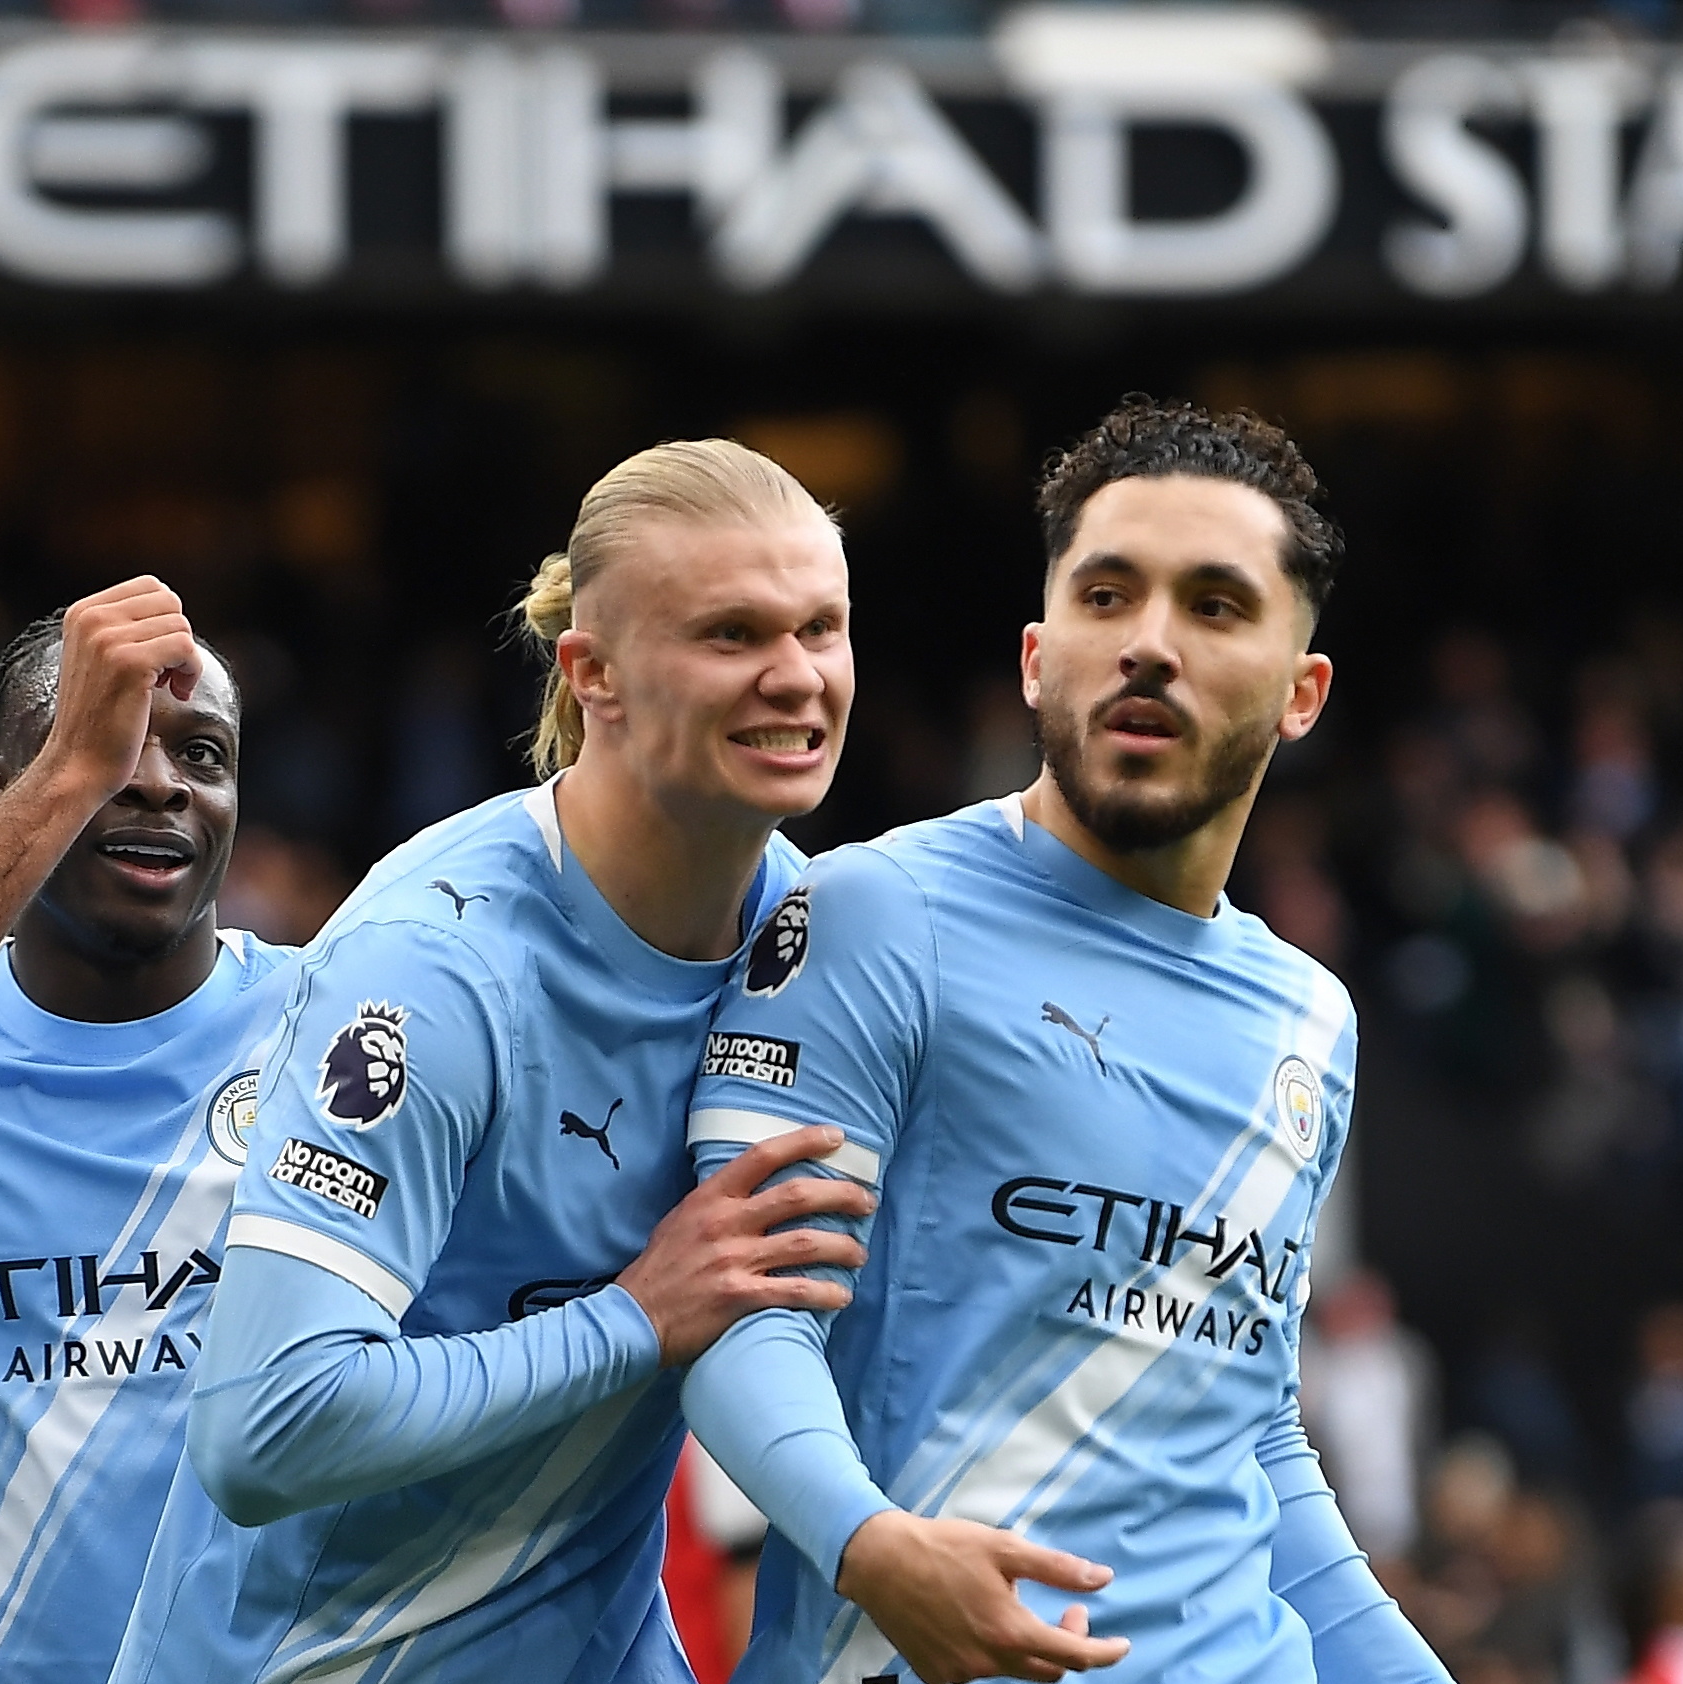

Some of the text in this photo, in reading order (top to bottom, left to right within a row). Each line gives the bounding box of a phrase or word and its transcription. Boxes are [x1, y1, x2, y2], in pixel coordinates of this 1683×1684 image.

[706, 1033, 787, 1065] No room
[721, 1058, 794, 1086] racism
[268, 1157, 377, 1219] for racism
[280, 1138, 375, 1196] No room
[1067, 1278, 1271, 1356] AIRWAYS
